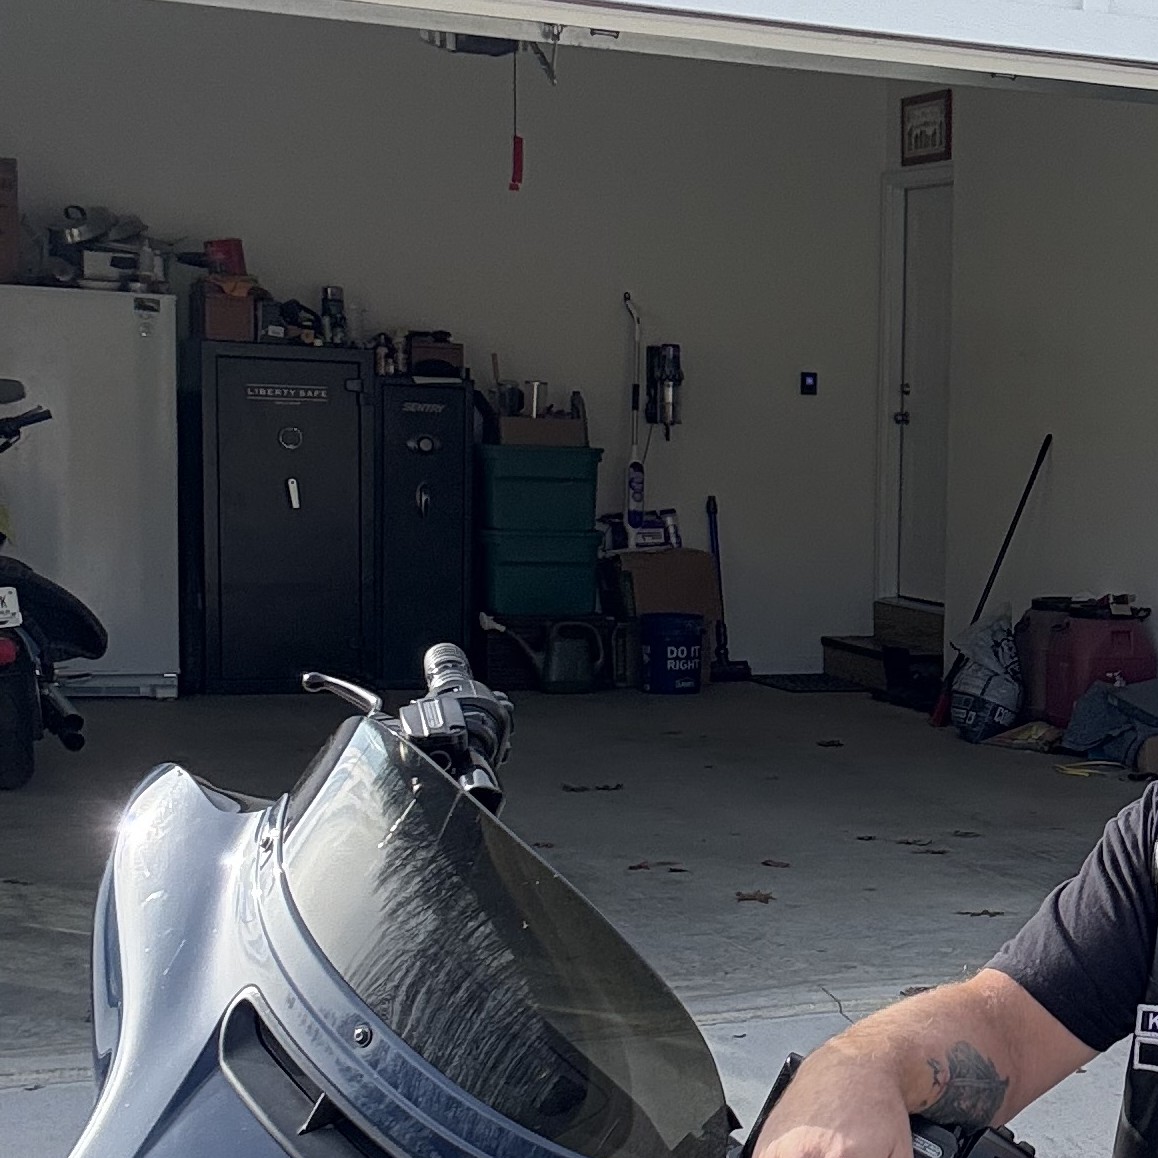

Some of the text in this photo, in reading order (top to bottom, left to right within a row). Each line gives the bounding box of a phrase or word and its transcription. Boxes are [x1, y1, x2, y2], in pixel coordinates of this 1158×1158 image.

[247, 387, 328, 398] LIBERTY SAFE
[667, 645, 701, 659] DO IT
[667, 659, 700, 671] RIGHT
